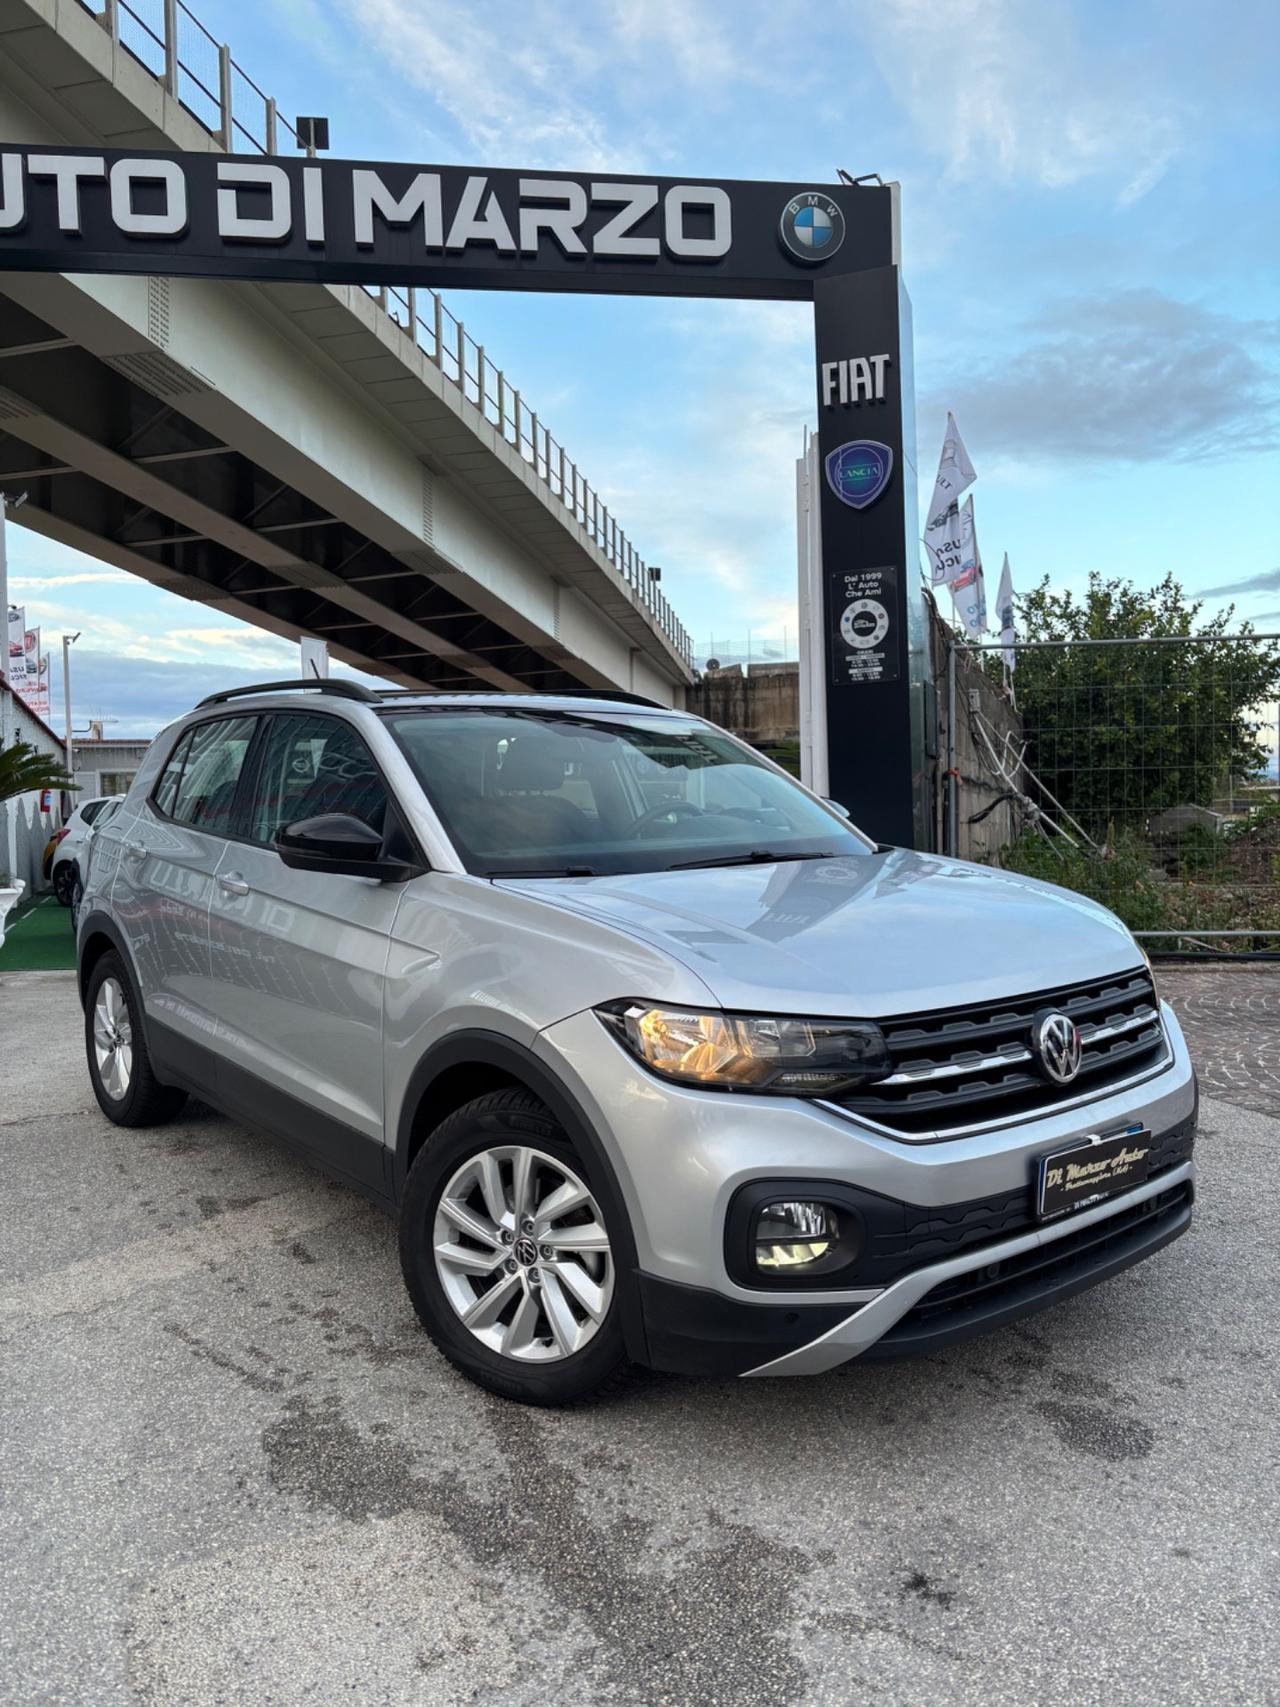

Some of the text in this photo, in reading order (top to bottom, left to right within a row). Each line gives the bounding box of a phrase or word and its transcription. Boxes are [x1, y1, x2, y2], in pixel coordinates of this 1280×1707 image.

[217, 162, 325, 242] DI
[352, 169, 732, 257] MARZO
[789, 196, 838, 216] BMW
[822, 354, 890, 406] FIAT
[840, 466, 879, 479] LANCIA
[844, 572, 882, 583] Dal 1999
[859, 581, 879, 589] Auto
[845, 587, 882, 598] Che Ami
[1047, 1148, 1149, 1188] Di Marzo Auto
